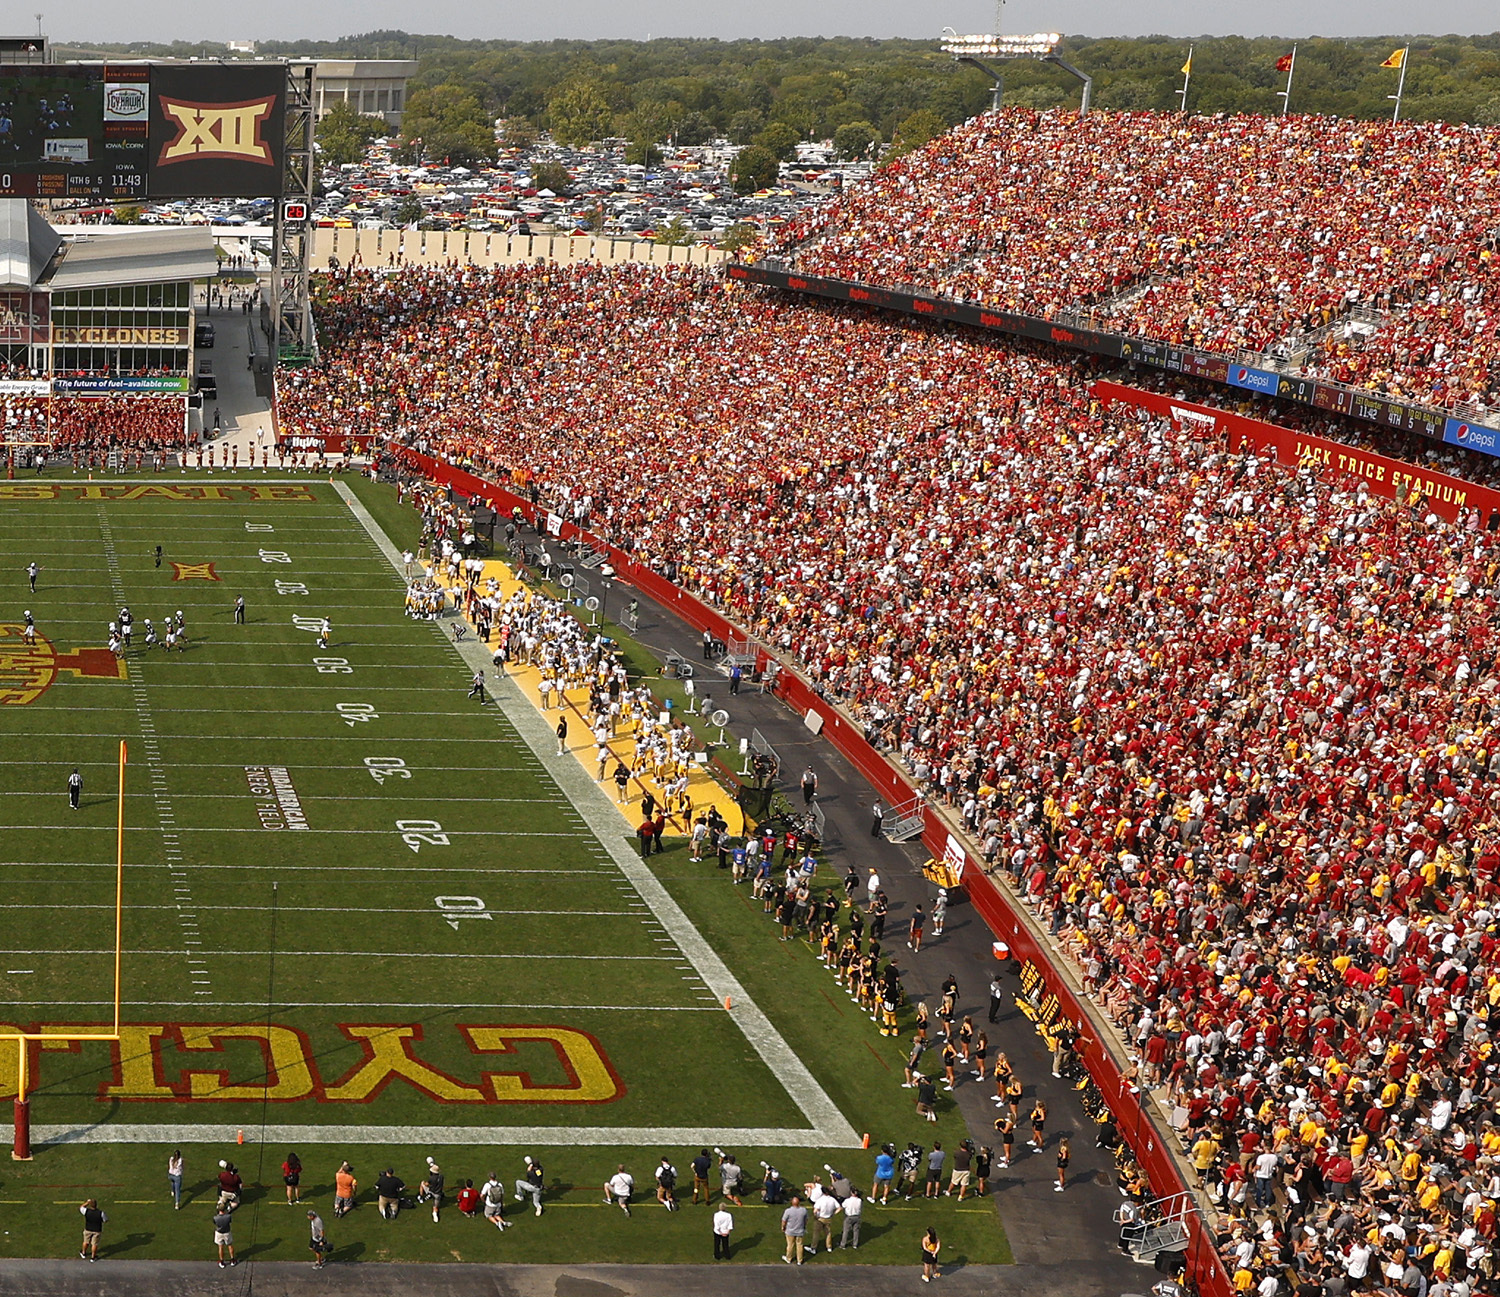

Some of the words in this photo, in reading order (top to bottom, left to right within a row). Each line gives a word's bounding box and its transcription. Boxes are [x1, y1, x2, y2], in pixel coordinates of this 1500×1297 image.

[2, 174, 11, 188] 0
[69, 176, 84, 184] 4TH
[97, 176, 103, 184] 5
[111, 174, 141, 186] 11:43
[288, 206, 303, 218] 26
[55, 328, 180, 344] CYCLONES
[11, 383, 30, 393] Energy
[31, 383, 48, 393] Group
[58, 379, 73, 387] The
[74, 380, 98, 388] future
[99, 379, 109, 388] of
[1247, 373, 1269, 388] pepsi
[1298, 382, 1305, 395] 0
[1338, 392, 1344, 404] 0
[1355, 395, 1364, 405] 1ST
[1364, 396, 1382, 410] Quarter
[1358, 405, 1377, 420] 11:42
[1387, 402, 1403, 415] DOWN
[1407, 407, 1414, 418] TO
[1414, 409, 1422, 420] GO
[1388, 413, 1401, 426] 4TH
[1408, 417, 1413, 429] 5
[1425, 422, 1435, 434] 44
[1469, 431, 1495, 448] pepsi
[1338, 454, 1385, 482] TRICE
[1391, 470, 1468, 506] STADIUM
[258, 549, 292, 563] 20
[275, 580, 310, 595] 30
[313, 657, 353, 674] 50
[336, 703, 379, 722] 40
[363, 756, 412, 780] 30
[244, 766, 275, 801] ENERGY
[267, 766, 310, 830] MIDAMERICAN
[255, 802, 284, 830] FIELD
[395, 819, 451, 846] 20
[434, 895, 493, 921] 10
